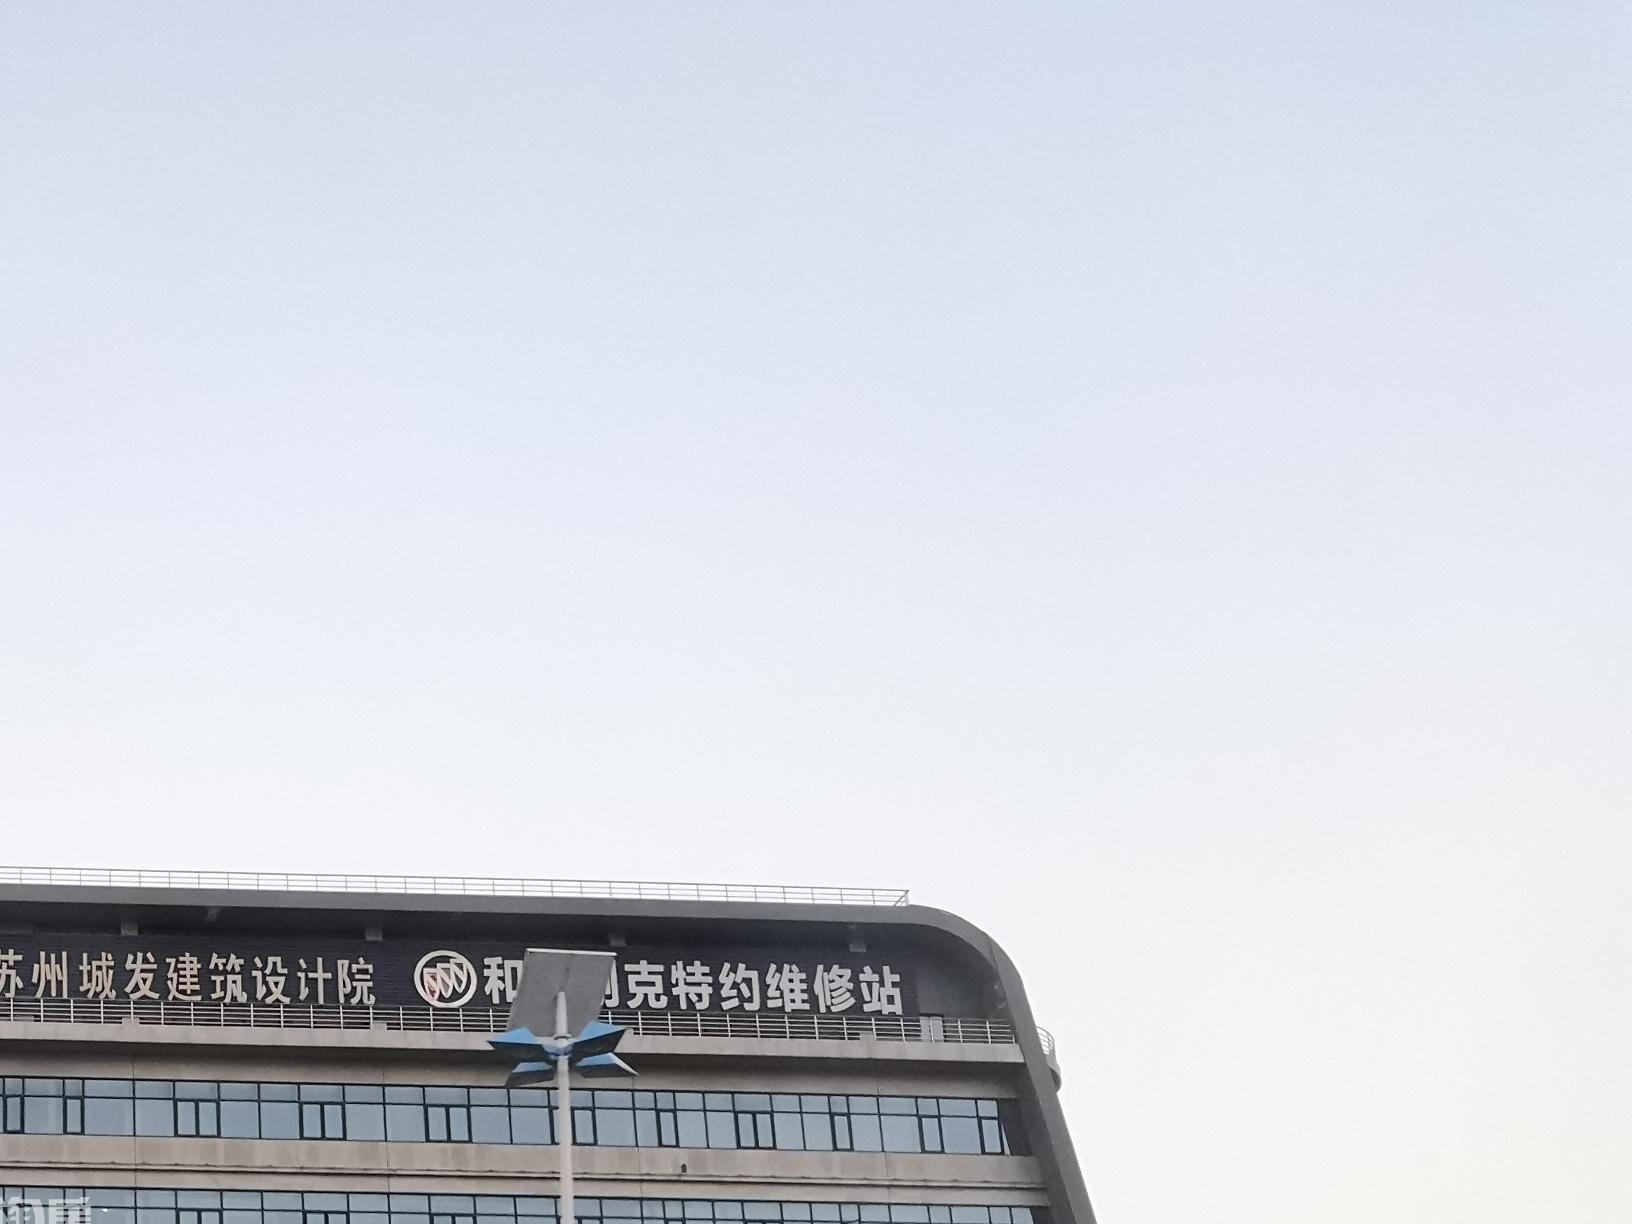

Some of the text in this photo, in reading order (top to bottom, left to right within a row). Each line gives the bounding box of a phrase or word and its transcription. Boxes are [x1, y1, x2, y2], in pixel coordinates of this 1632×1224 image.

[484, 955, 903, 1016] 和克特约维修站
